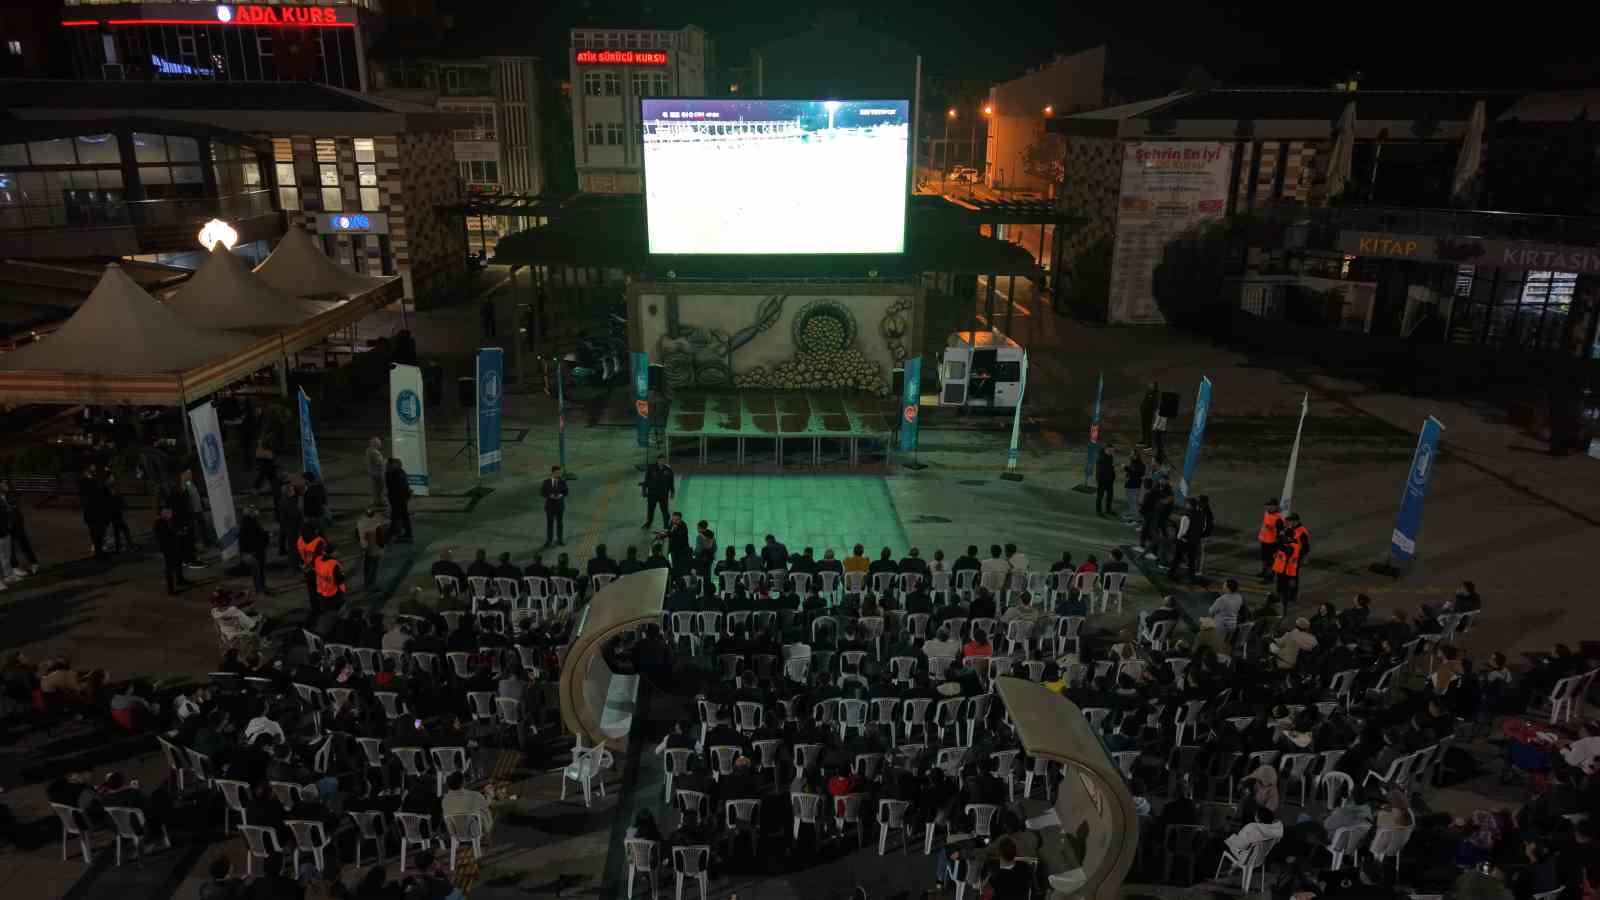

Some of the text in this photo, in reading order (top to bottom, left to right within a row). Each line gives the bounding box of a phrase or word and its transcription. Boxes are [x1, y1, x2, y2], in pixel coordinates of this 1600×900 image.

[236, 5, 336, 23] ADA KURS
[635, 52, 665, 64] KURSU
[1183, 148, 1200, 160] En
